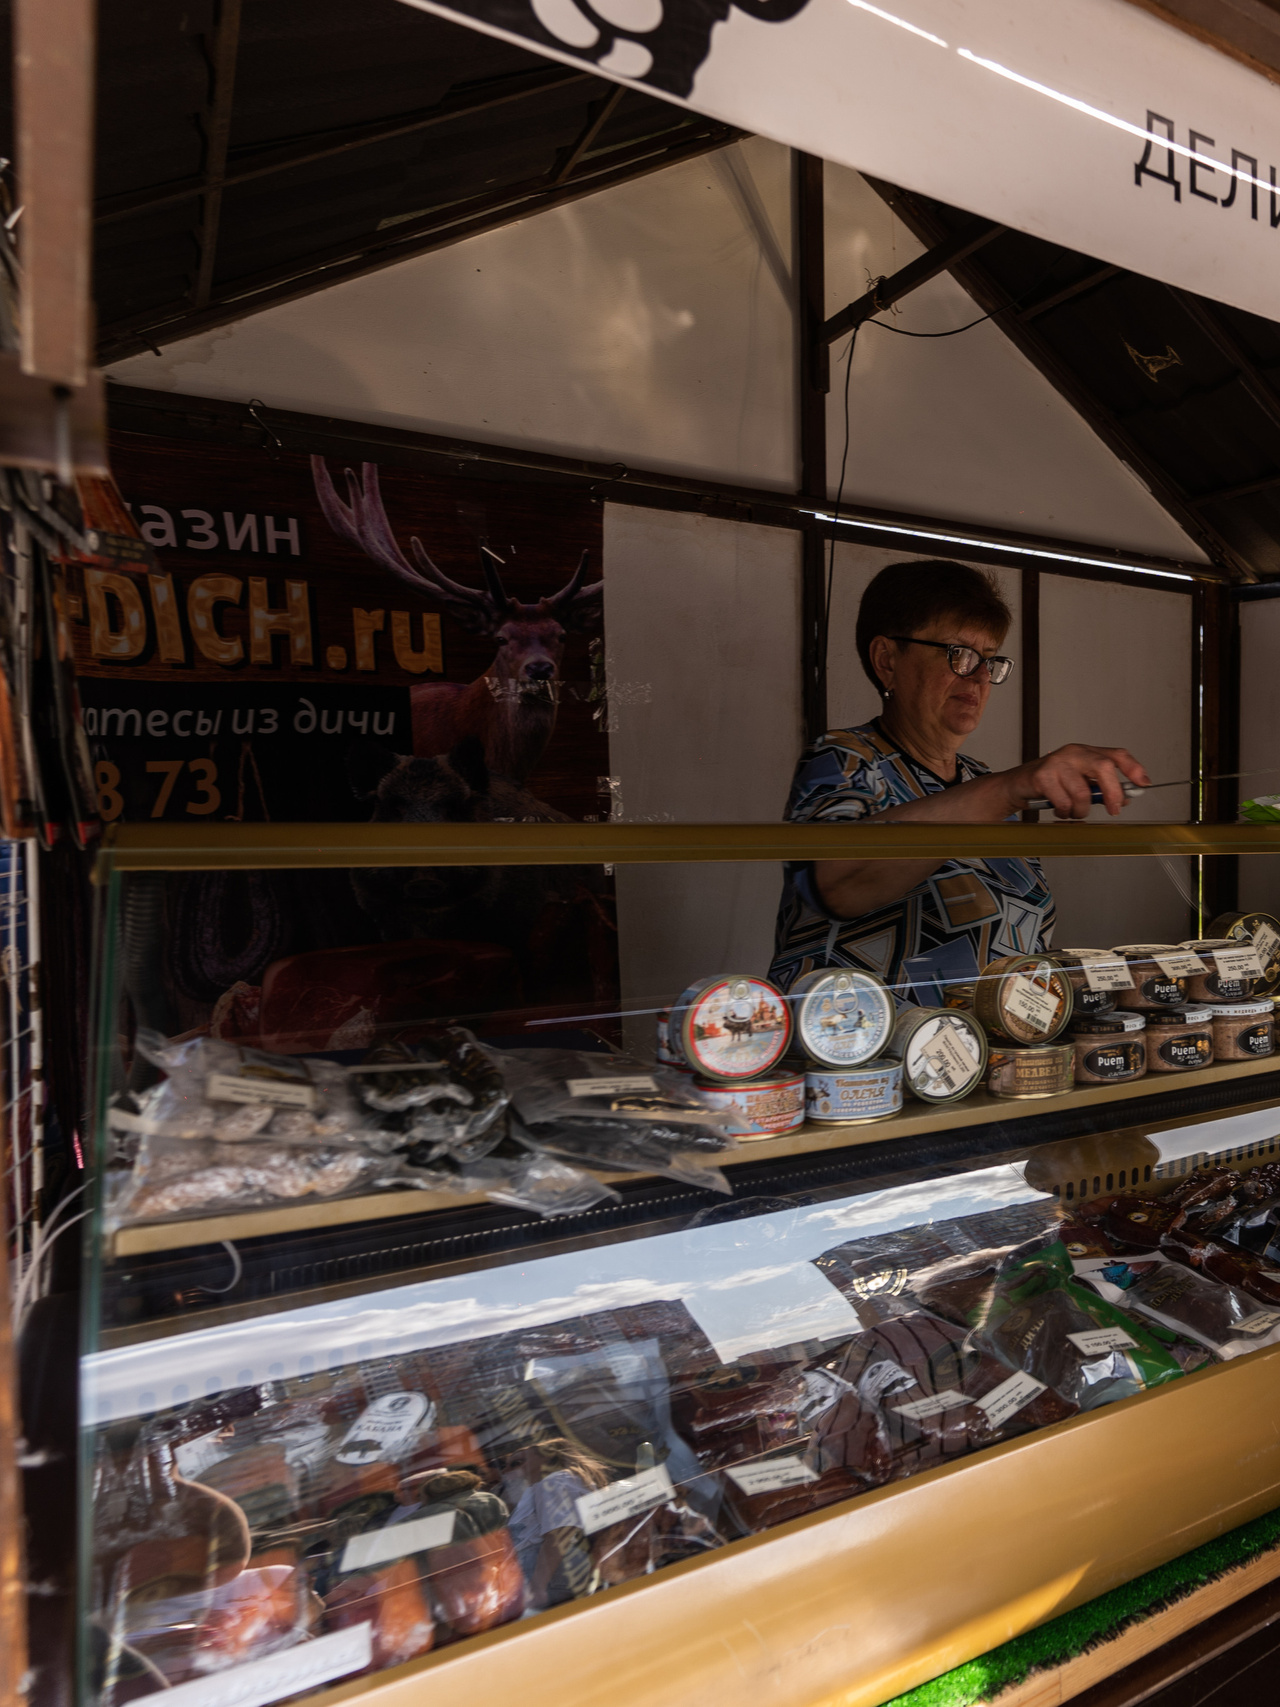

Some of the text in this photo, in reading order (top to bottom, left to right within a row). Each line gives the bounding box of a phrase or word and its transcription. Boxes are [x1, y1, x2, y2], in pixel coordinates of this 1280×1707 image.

[125, 502, 300, 556] азин
[231, 707, 279, 735] из
[293, 696, 396, 736] дичи
[145, 757, 222, 819] 73
[1016, 1065, 1063, 1078] МЕДВЕДЯ
[840, 1085, 886, 1101] ОЛЕНЯ
[1019, 1319, 1045, 1350] ДИЧЬ
